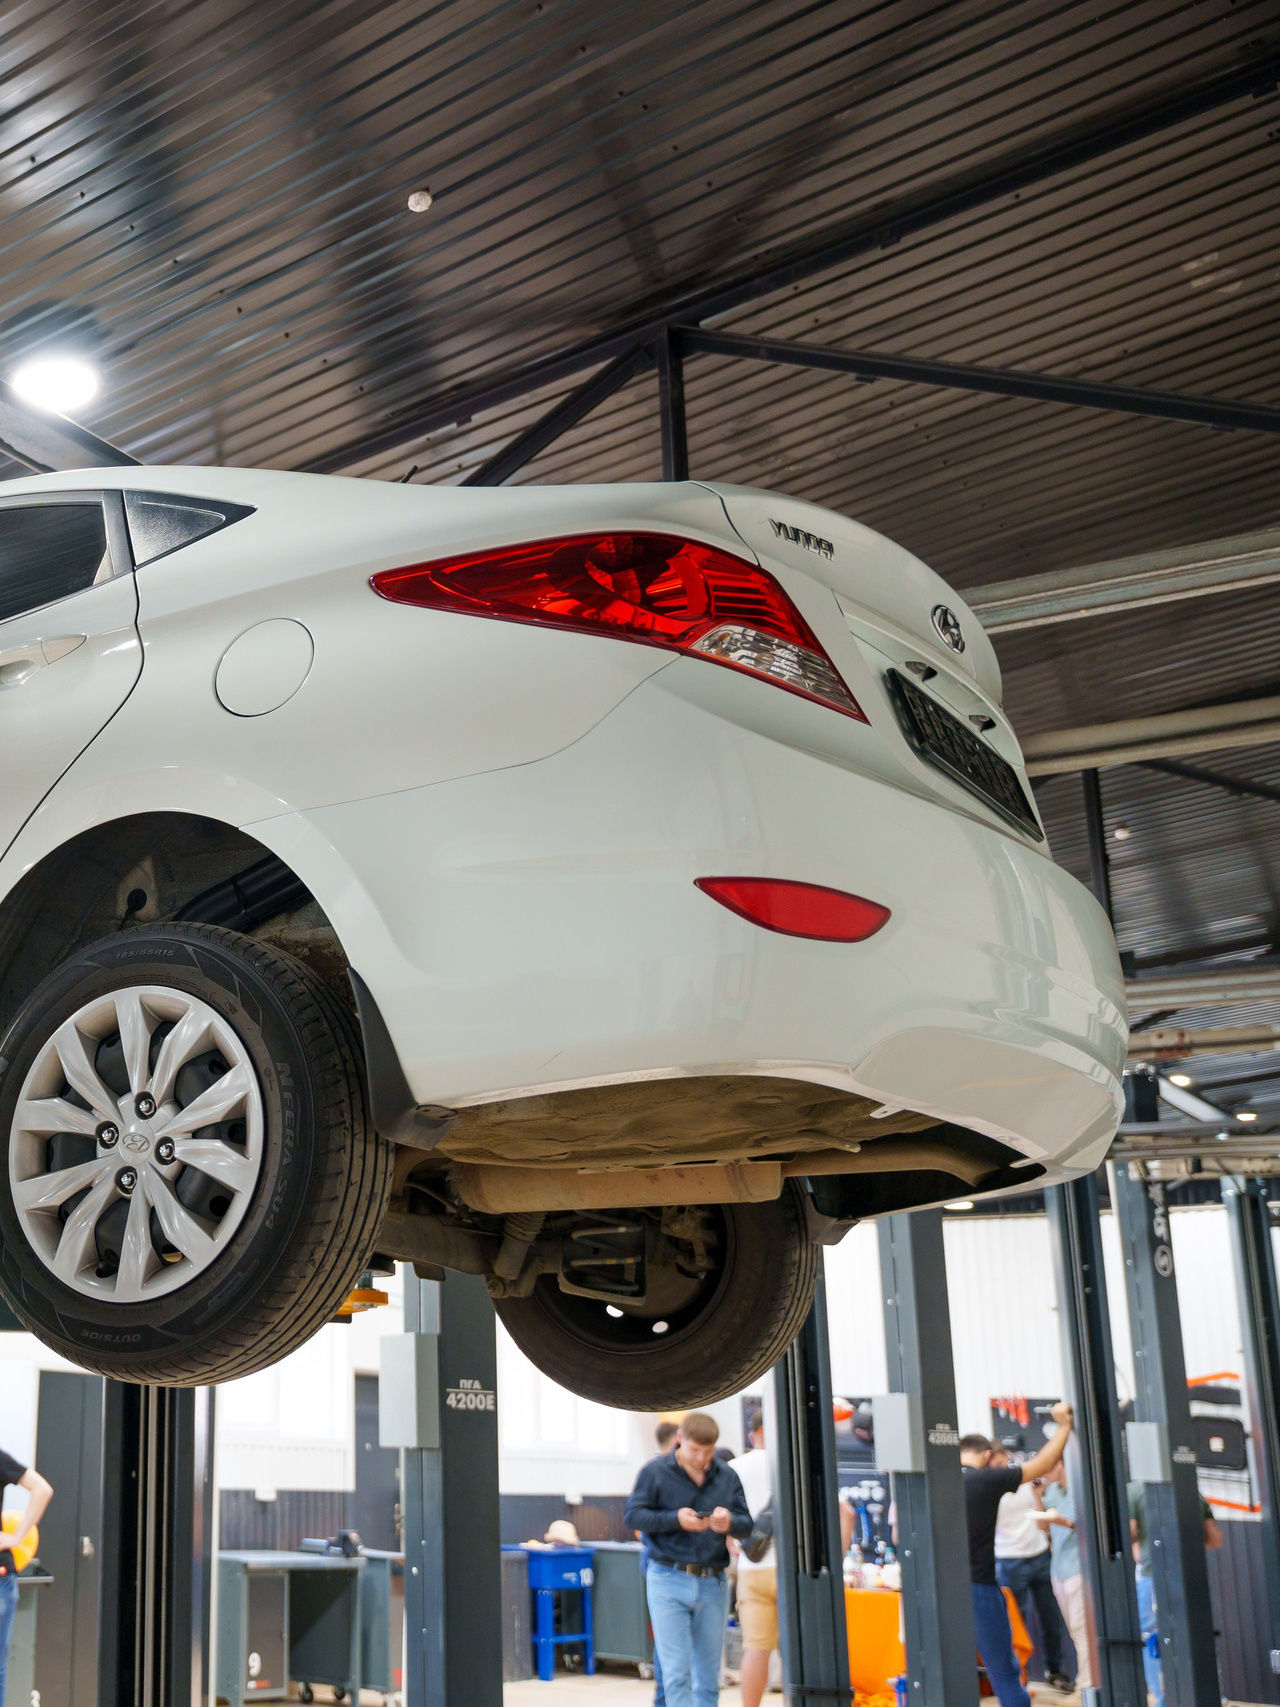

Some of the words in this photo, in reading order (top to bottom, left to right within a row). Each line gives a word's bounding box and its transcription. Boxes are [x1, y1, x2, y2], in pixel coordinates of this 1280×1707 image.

[80, 1328, 142, 1343] OUTSIDE
[459, 1378, 483, 1390] ПГА
[446, 1392, 495, 1411] 4200E
[248, 1651, 262, 1677] 9
